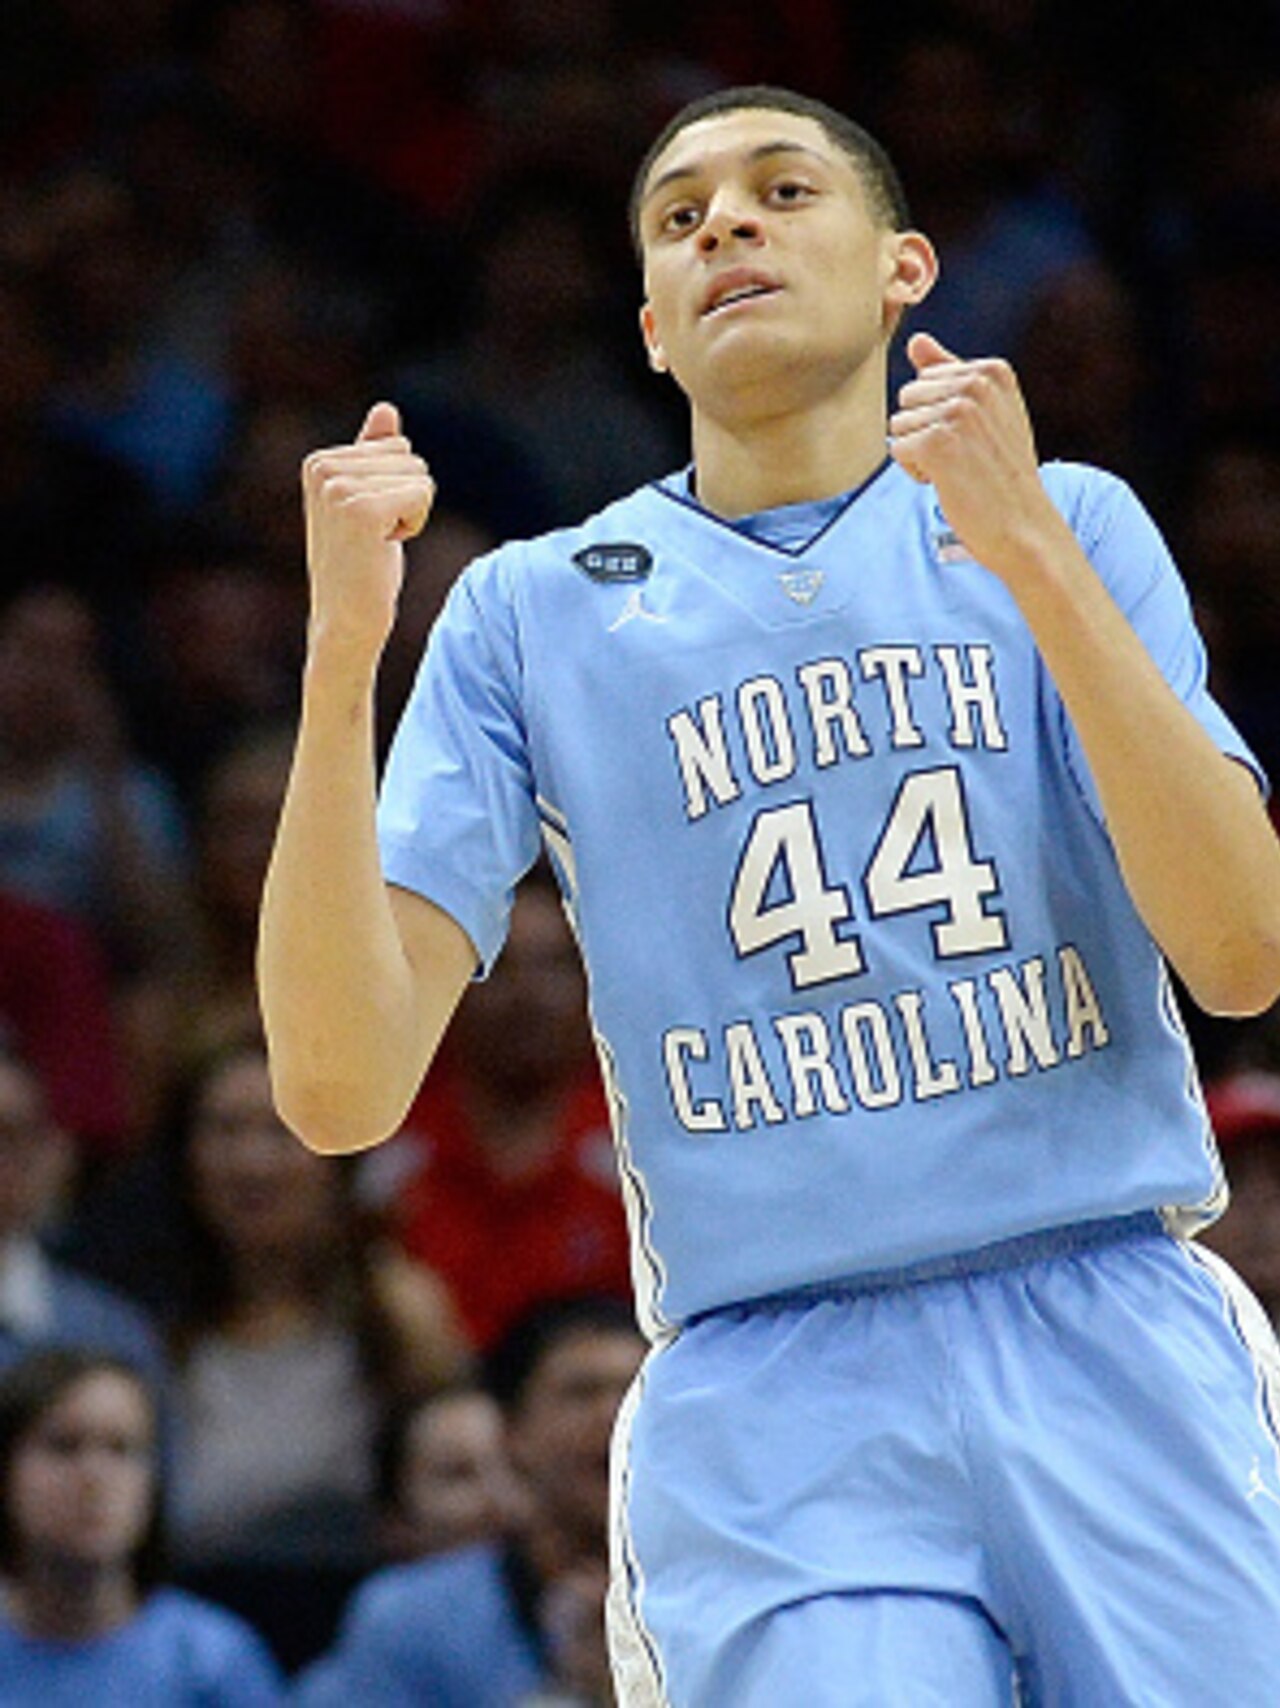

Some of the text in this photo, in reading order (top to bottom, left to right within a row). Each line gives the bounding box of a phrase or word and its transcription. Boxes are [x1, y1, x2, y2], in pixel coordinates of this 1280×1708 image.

[667, 644, 1009, 821] NORTH
[726, 764, 1011, 992] 44
[663, 945, 1111, 1134] CAROLINA
